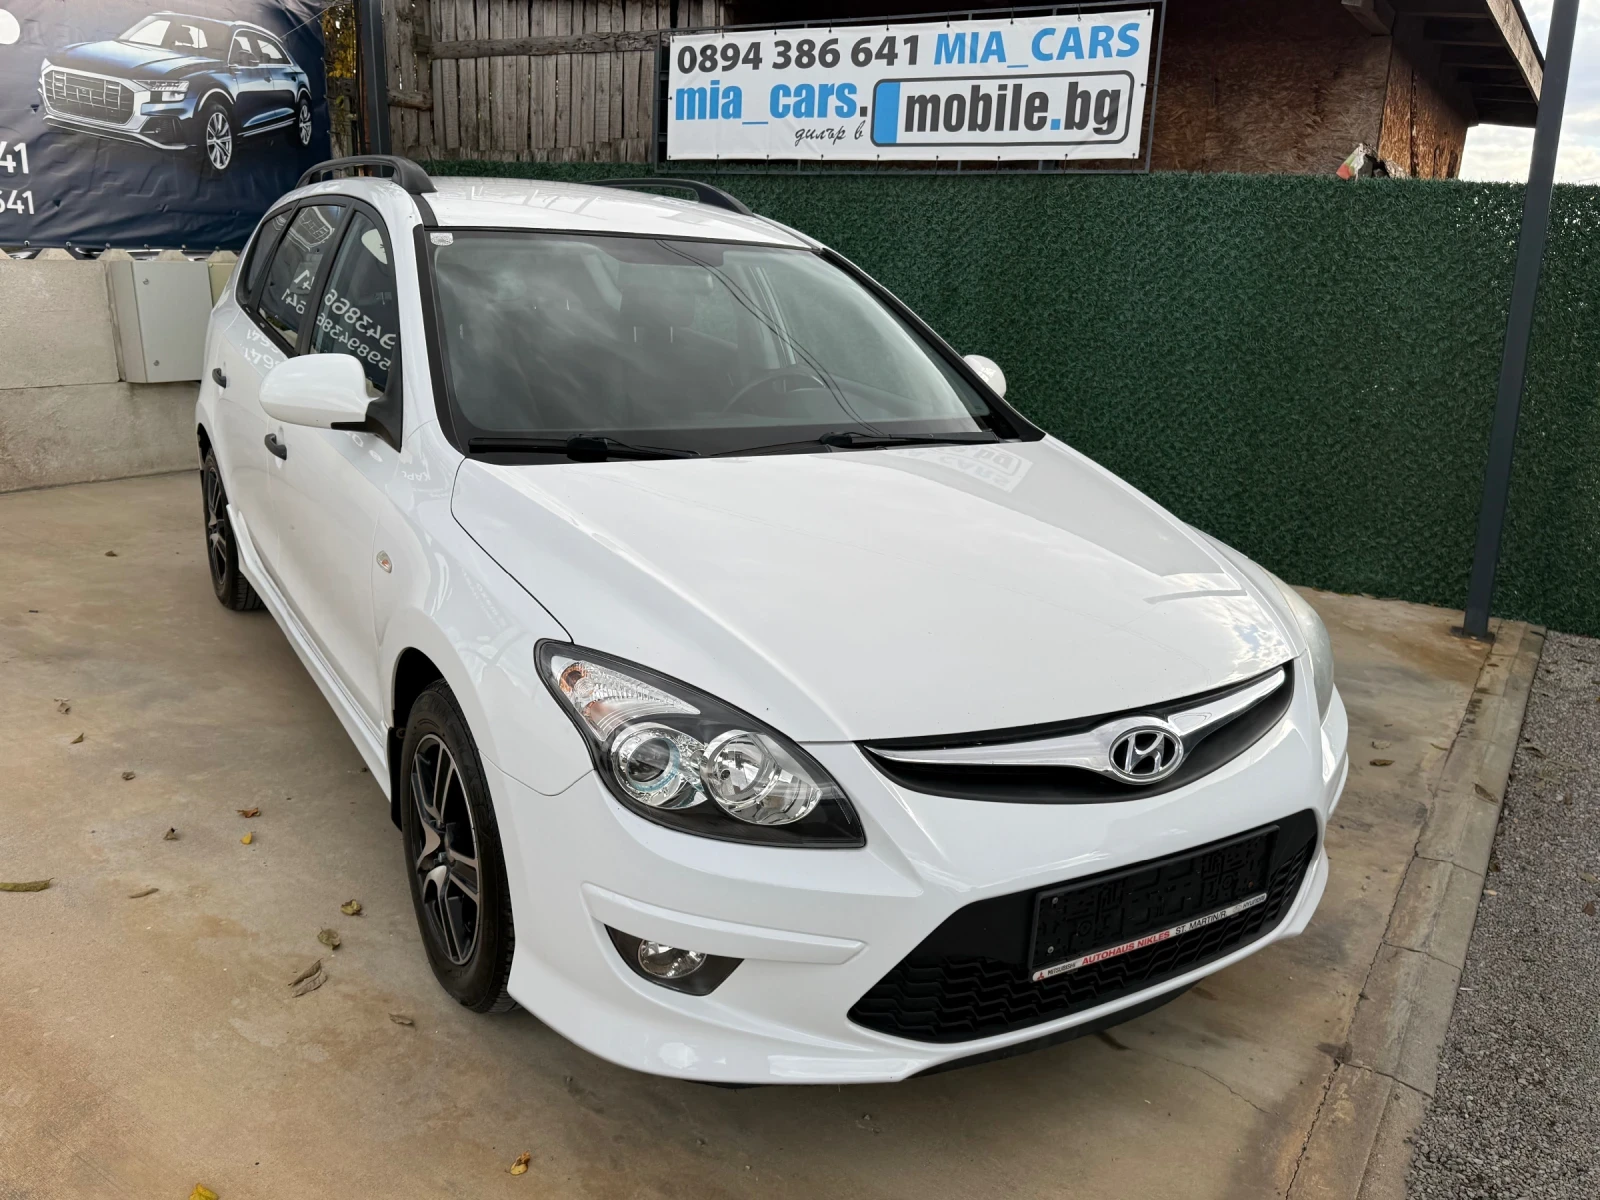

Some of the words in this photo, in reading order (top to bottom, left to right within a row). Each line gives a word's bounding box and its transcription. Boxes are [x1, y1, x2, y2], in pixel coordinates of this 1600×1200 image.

[677, 41, 763, 74] 0894
[772, 38, 841, 70] 386
[850, 35, 920, 68] 641
[933, 23, 1141, 68] MIA_CARS
[904, 81, 1122, 135] mobile.bg
[795, 125, 846, 147] дилър
[1081, 942, 1134, 966] AUTOHAUS
[1137, 930, 1170, 950] NIKLES
[1175, 925, 1187, 935] ST.
